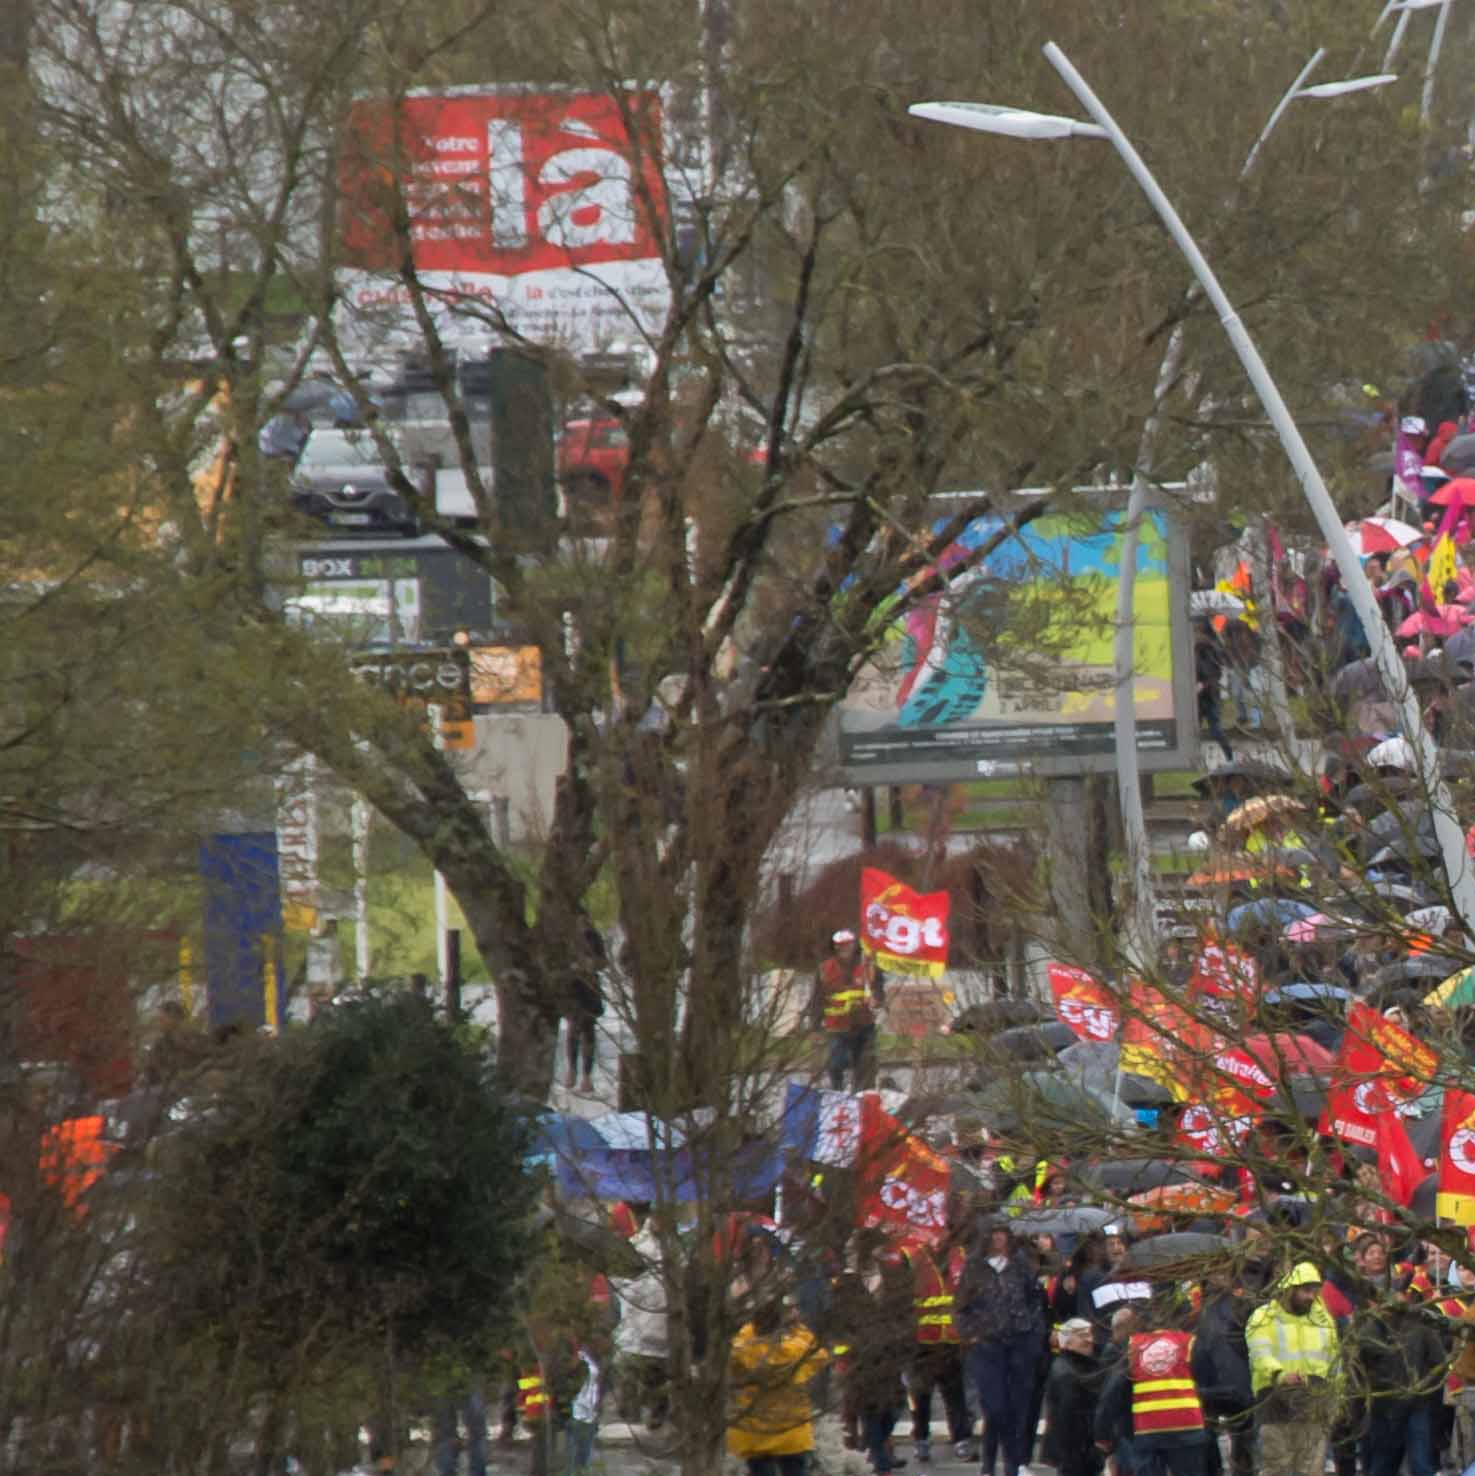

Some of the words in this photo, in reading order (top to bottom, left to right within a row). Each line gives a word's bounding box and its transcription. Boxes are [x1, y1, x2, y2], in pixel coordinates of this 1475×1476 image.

[488, 116, 637, 248] là
[302, 559, 351, 577] BOX
[866, 903, 944, 955] cgt
